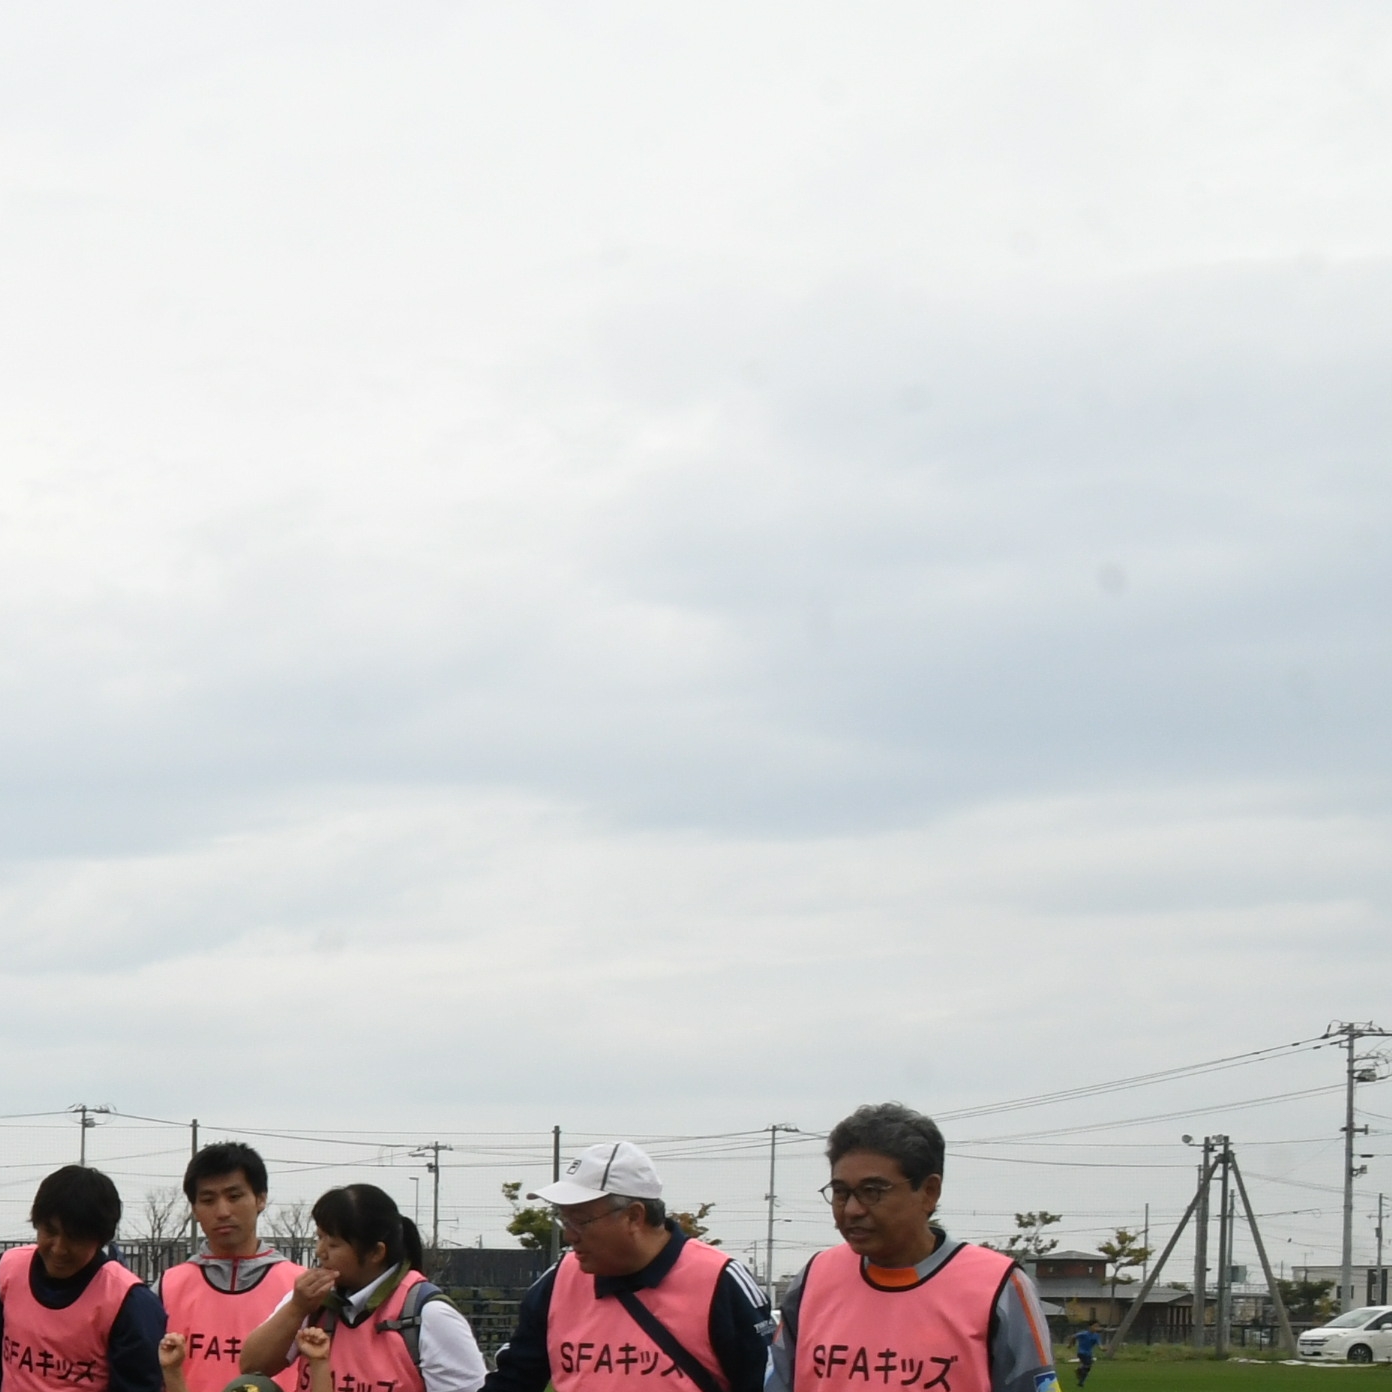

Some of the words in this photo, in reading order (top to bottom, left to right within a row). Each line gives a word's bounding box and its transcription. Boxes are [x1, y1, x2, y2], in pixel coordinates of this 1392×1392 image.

[3, 1336, 96, 1383] SFAキッズ
[813, 1344, 959, 1392] SFAキッズ
